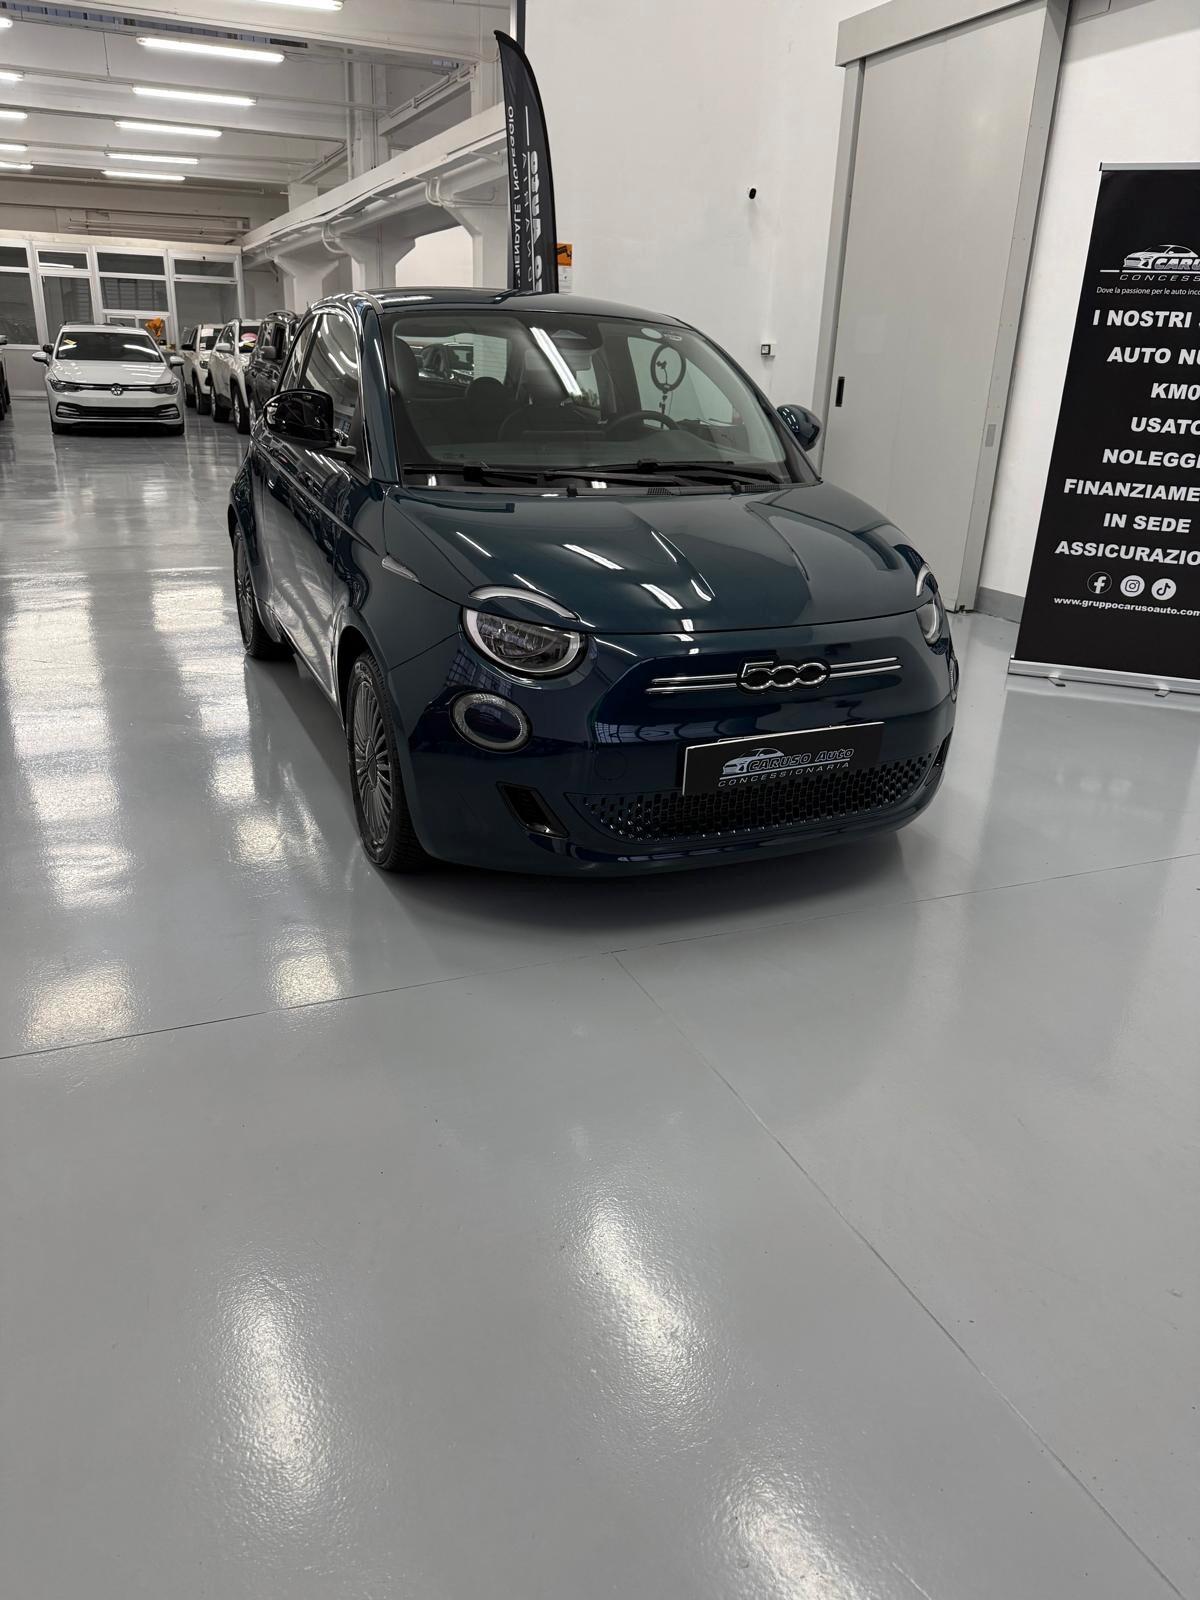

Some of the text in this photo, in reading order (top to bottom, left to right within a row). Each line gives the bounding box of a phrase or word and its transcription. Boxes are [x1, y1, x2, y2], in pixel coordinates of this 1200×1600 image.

[1096, 286, 1114, 294] Dove
[1114, 286, 1121, 294] la
[1121, 287, 1151, 296] passione
[1163, 287, 1170, 295] le
[1093, 310, 1193, 328] I NOSTRI
[1107, 347, 1200, 365] AUTO N
[1063, 478, 1200, 502] FINANZIAME
[1103, 513, 1192, 533] IN SEDE
[1054, 540, 1200, 566] ASSICURAZIO
[739, 660, 827, 691] 500
[749, 748, 855, 772] CARUSO Auto
[717, 762, 850, 788] CONCESSIONARIA
